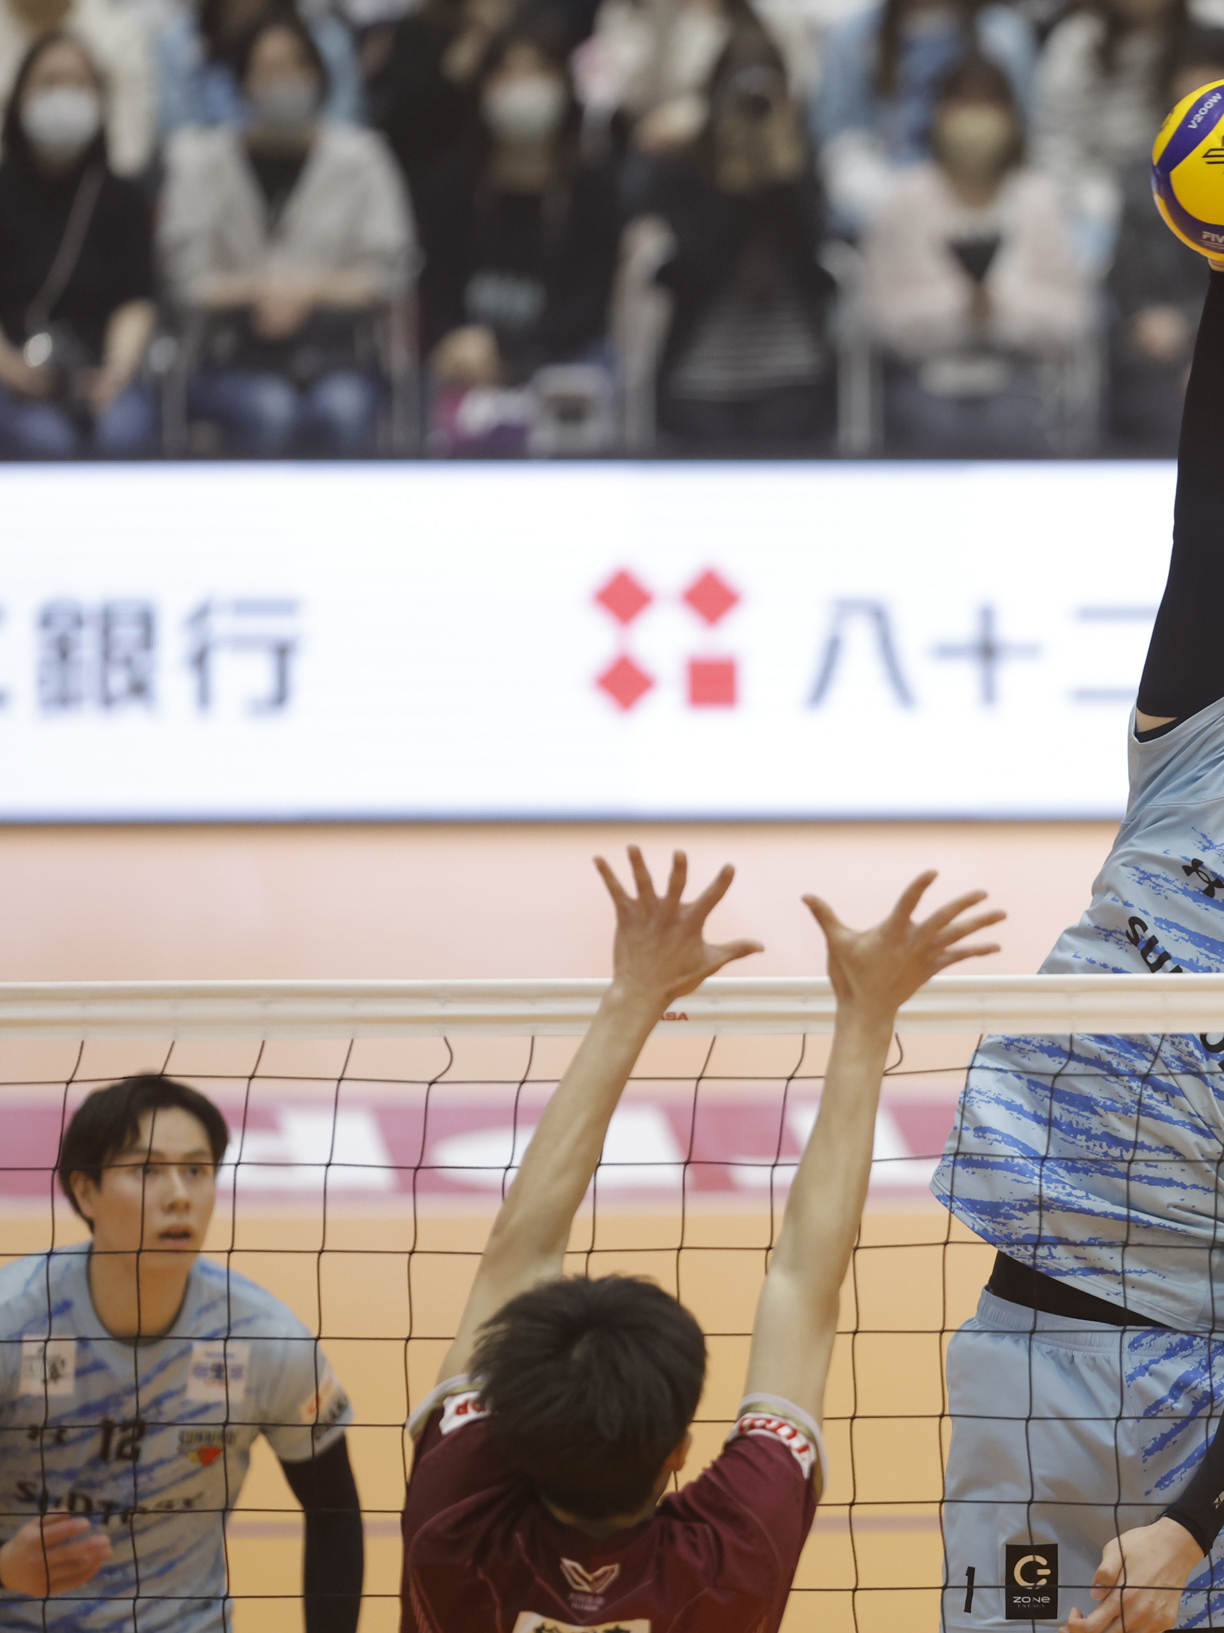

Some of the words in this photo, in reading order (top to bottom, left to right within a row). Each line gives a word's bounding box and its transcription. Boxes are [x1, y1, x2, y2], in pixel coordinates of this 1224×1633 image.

[1188, 92, 1223, 130] V200W
[0, 596, 302, 716] 銀行
[100, 1416, 147, 1463] 12
[963, 1565, 976, 1614] 1
